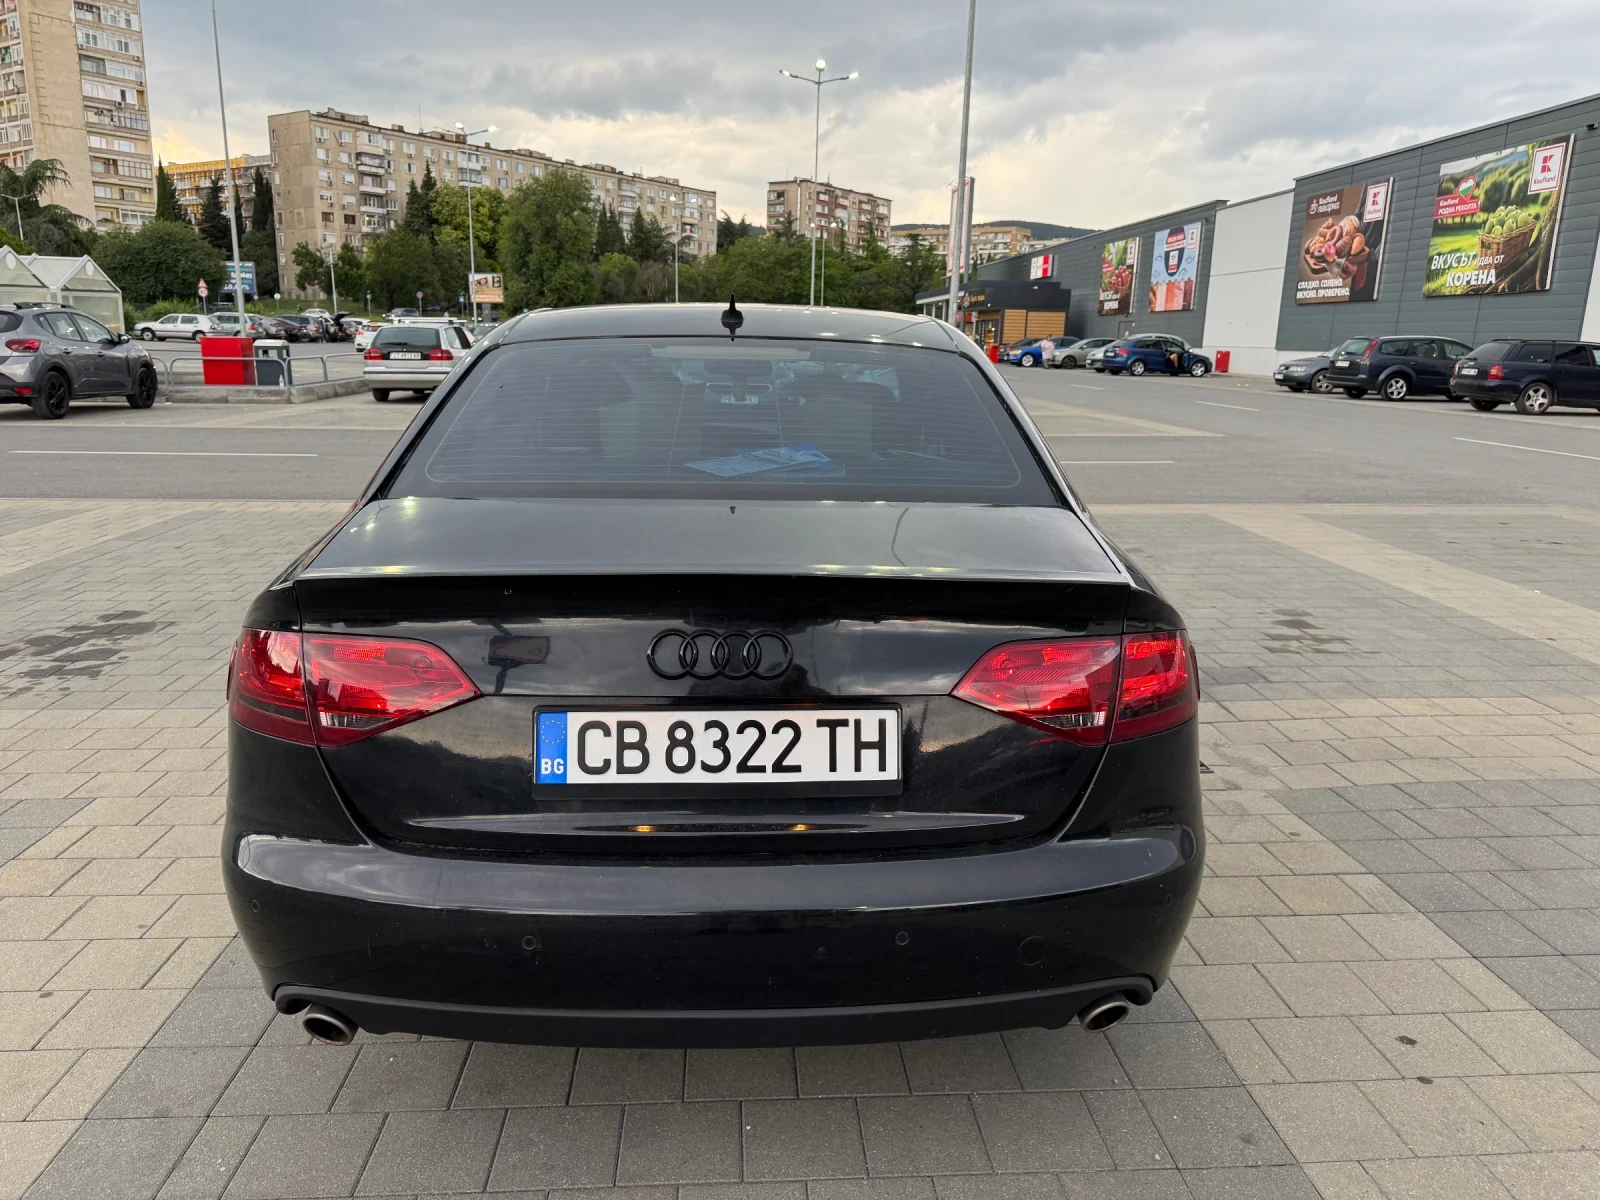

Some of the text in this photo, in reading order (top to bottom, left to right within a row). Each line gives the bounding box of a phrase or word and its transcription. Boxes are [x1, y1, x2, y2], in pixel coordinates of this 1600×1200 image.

[1540, 154, 1554, 173] K
[1533, 175, 1556, 185] Kaufland
[1318, 193, 1338, 205] Kaufland
[1440, 197, 1460, 206] Kaufland
[1438, 203, 1477, 215] РОДНА РЕКОЛТА
[1430, 251, 1505, 270] ВКУСЪТ ИДВА ОТ
[1446, 269, 1496, 287] КОРЕНА
[577, 718, 887, 775] CB 8322 TH
[541, 758, 564, 775] BG
